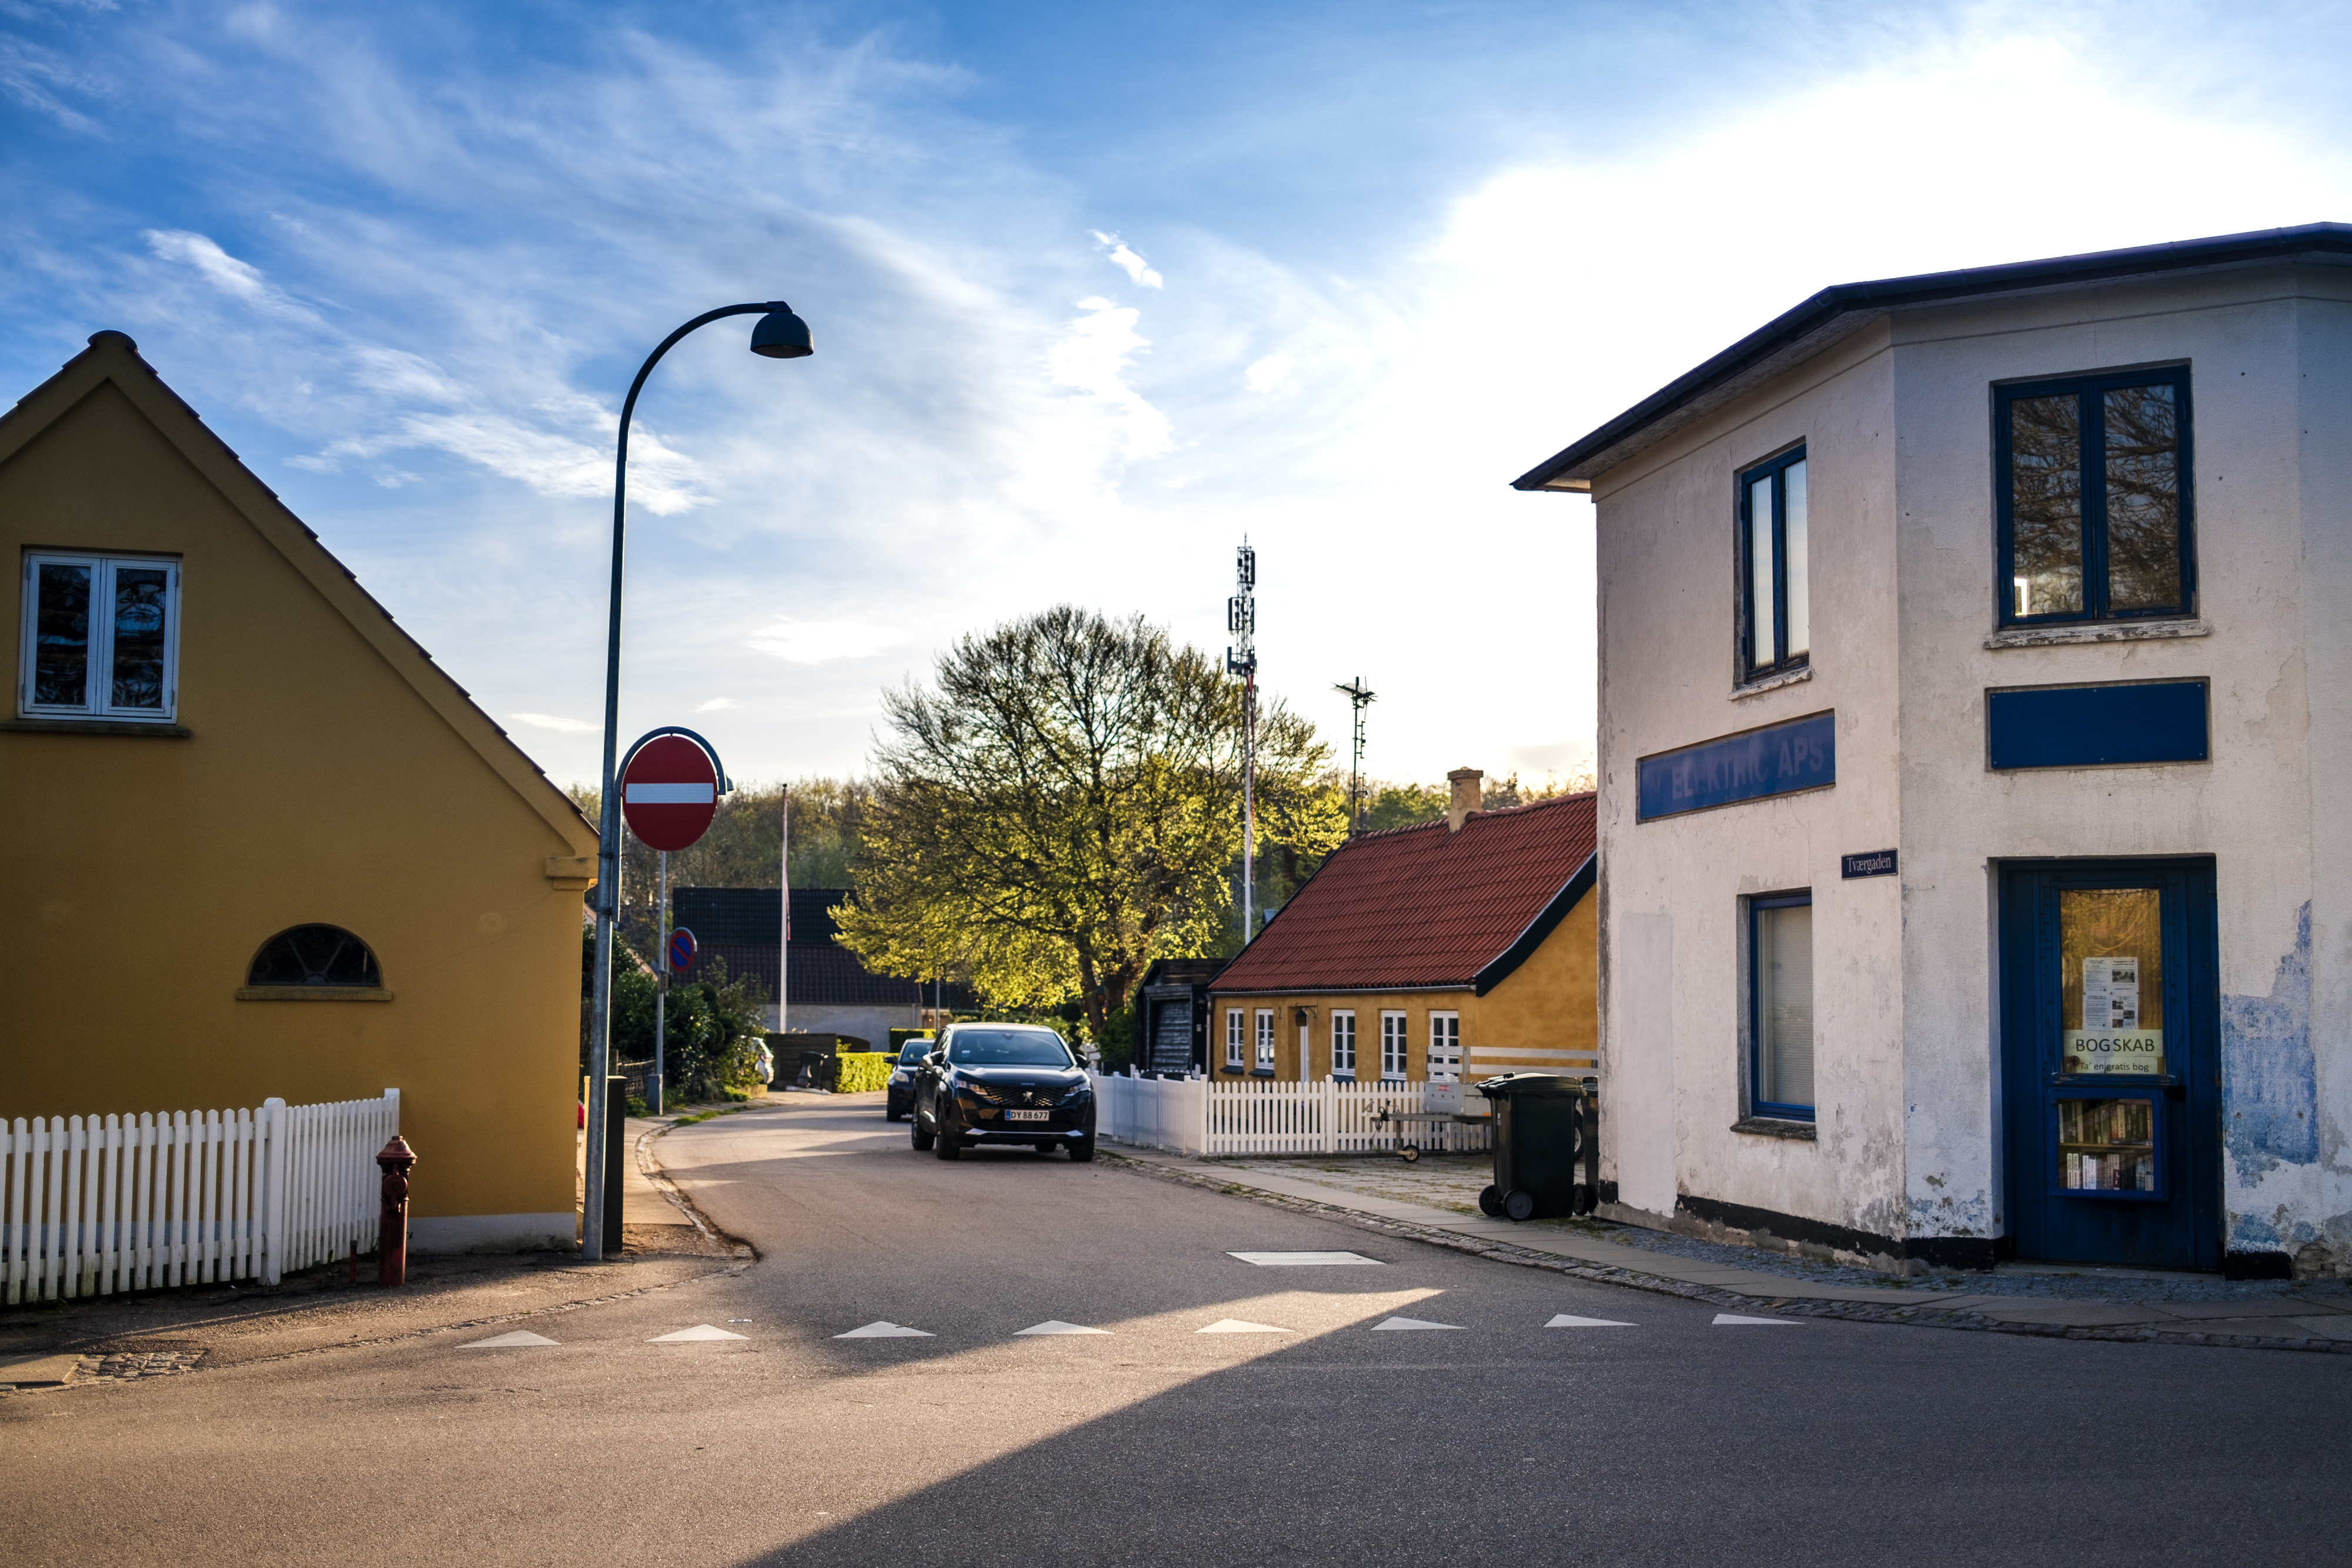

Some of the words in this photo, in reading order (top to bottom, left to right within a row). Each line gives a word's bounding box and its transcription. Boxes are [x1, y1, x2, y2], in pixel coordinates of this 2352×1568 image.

[1847, 854, 1891, 874] Tværgaden
[1278, 1006, 1282, 1019] 2
[2076, 1039, 2154, 1052] BOGSKAB
[2106, 1063, 2130, 1071] gratis
[2133, 1063, 2149, 1072] bog
